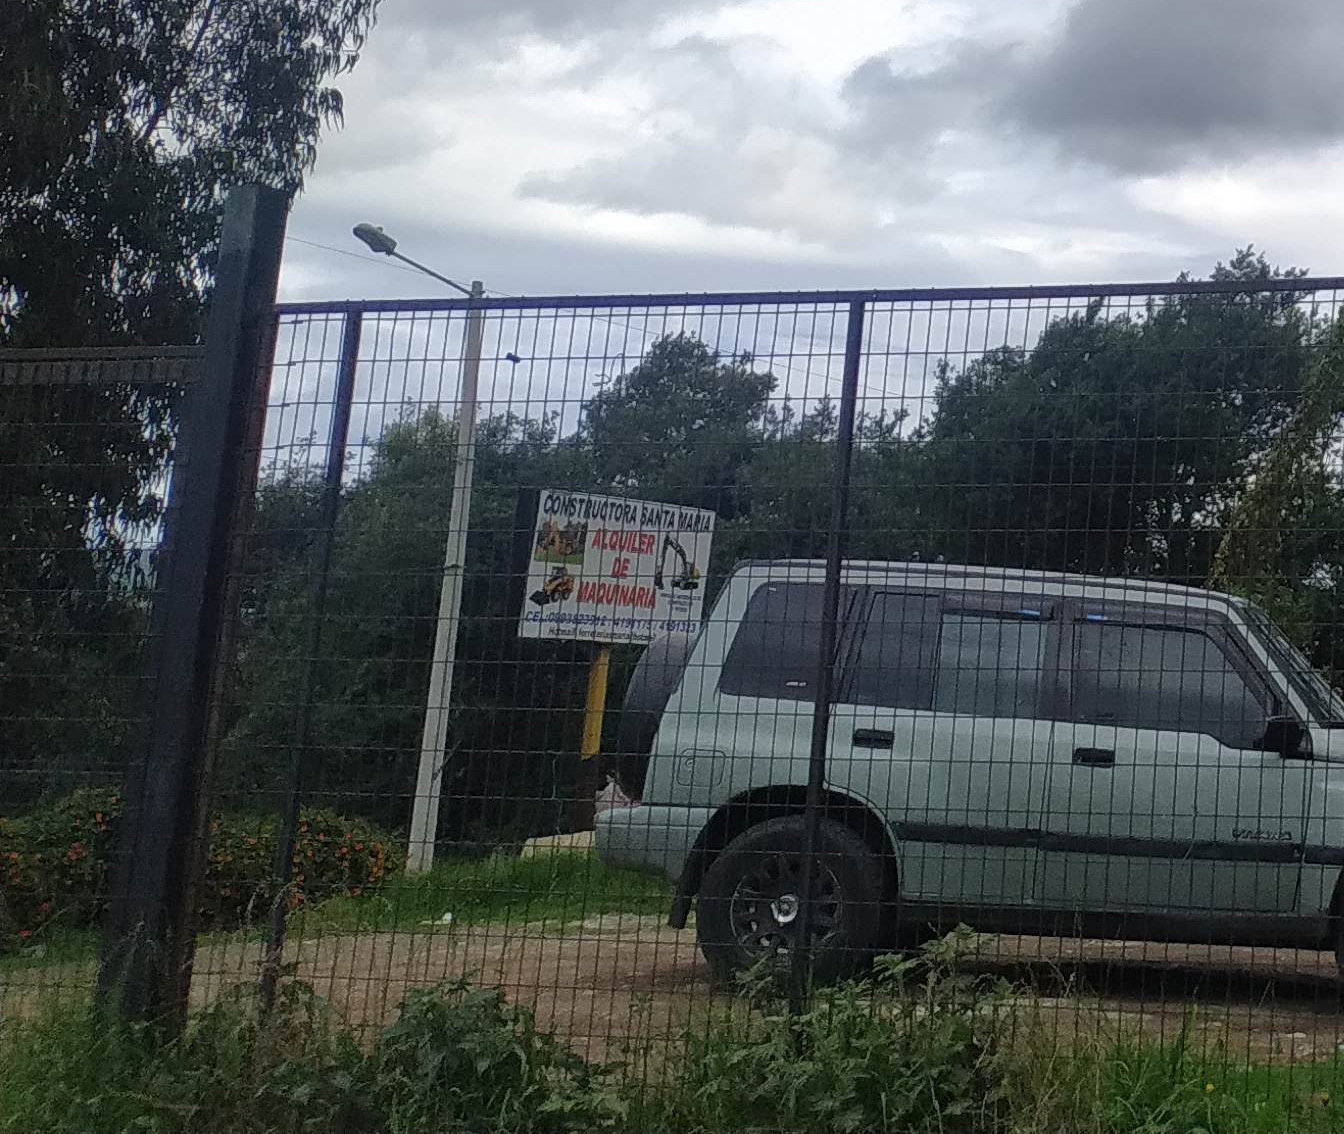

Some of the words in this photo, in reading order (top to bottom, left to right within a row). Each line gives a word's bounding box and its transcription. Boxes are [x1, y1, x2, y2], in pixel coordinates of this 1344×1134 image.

[543, 493, 637, 524] CONSTRUCTORA
[640, 505, 676, 530] SANTA
[677, 511, 712, 533] MARIA
[591, 528, 657, 555] ALQUILER
[611, 557, 630, 579] DE
[576, 581, 657, 610] MAQUINARIA
